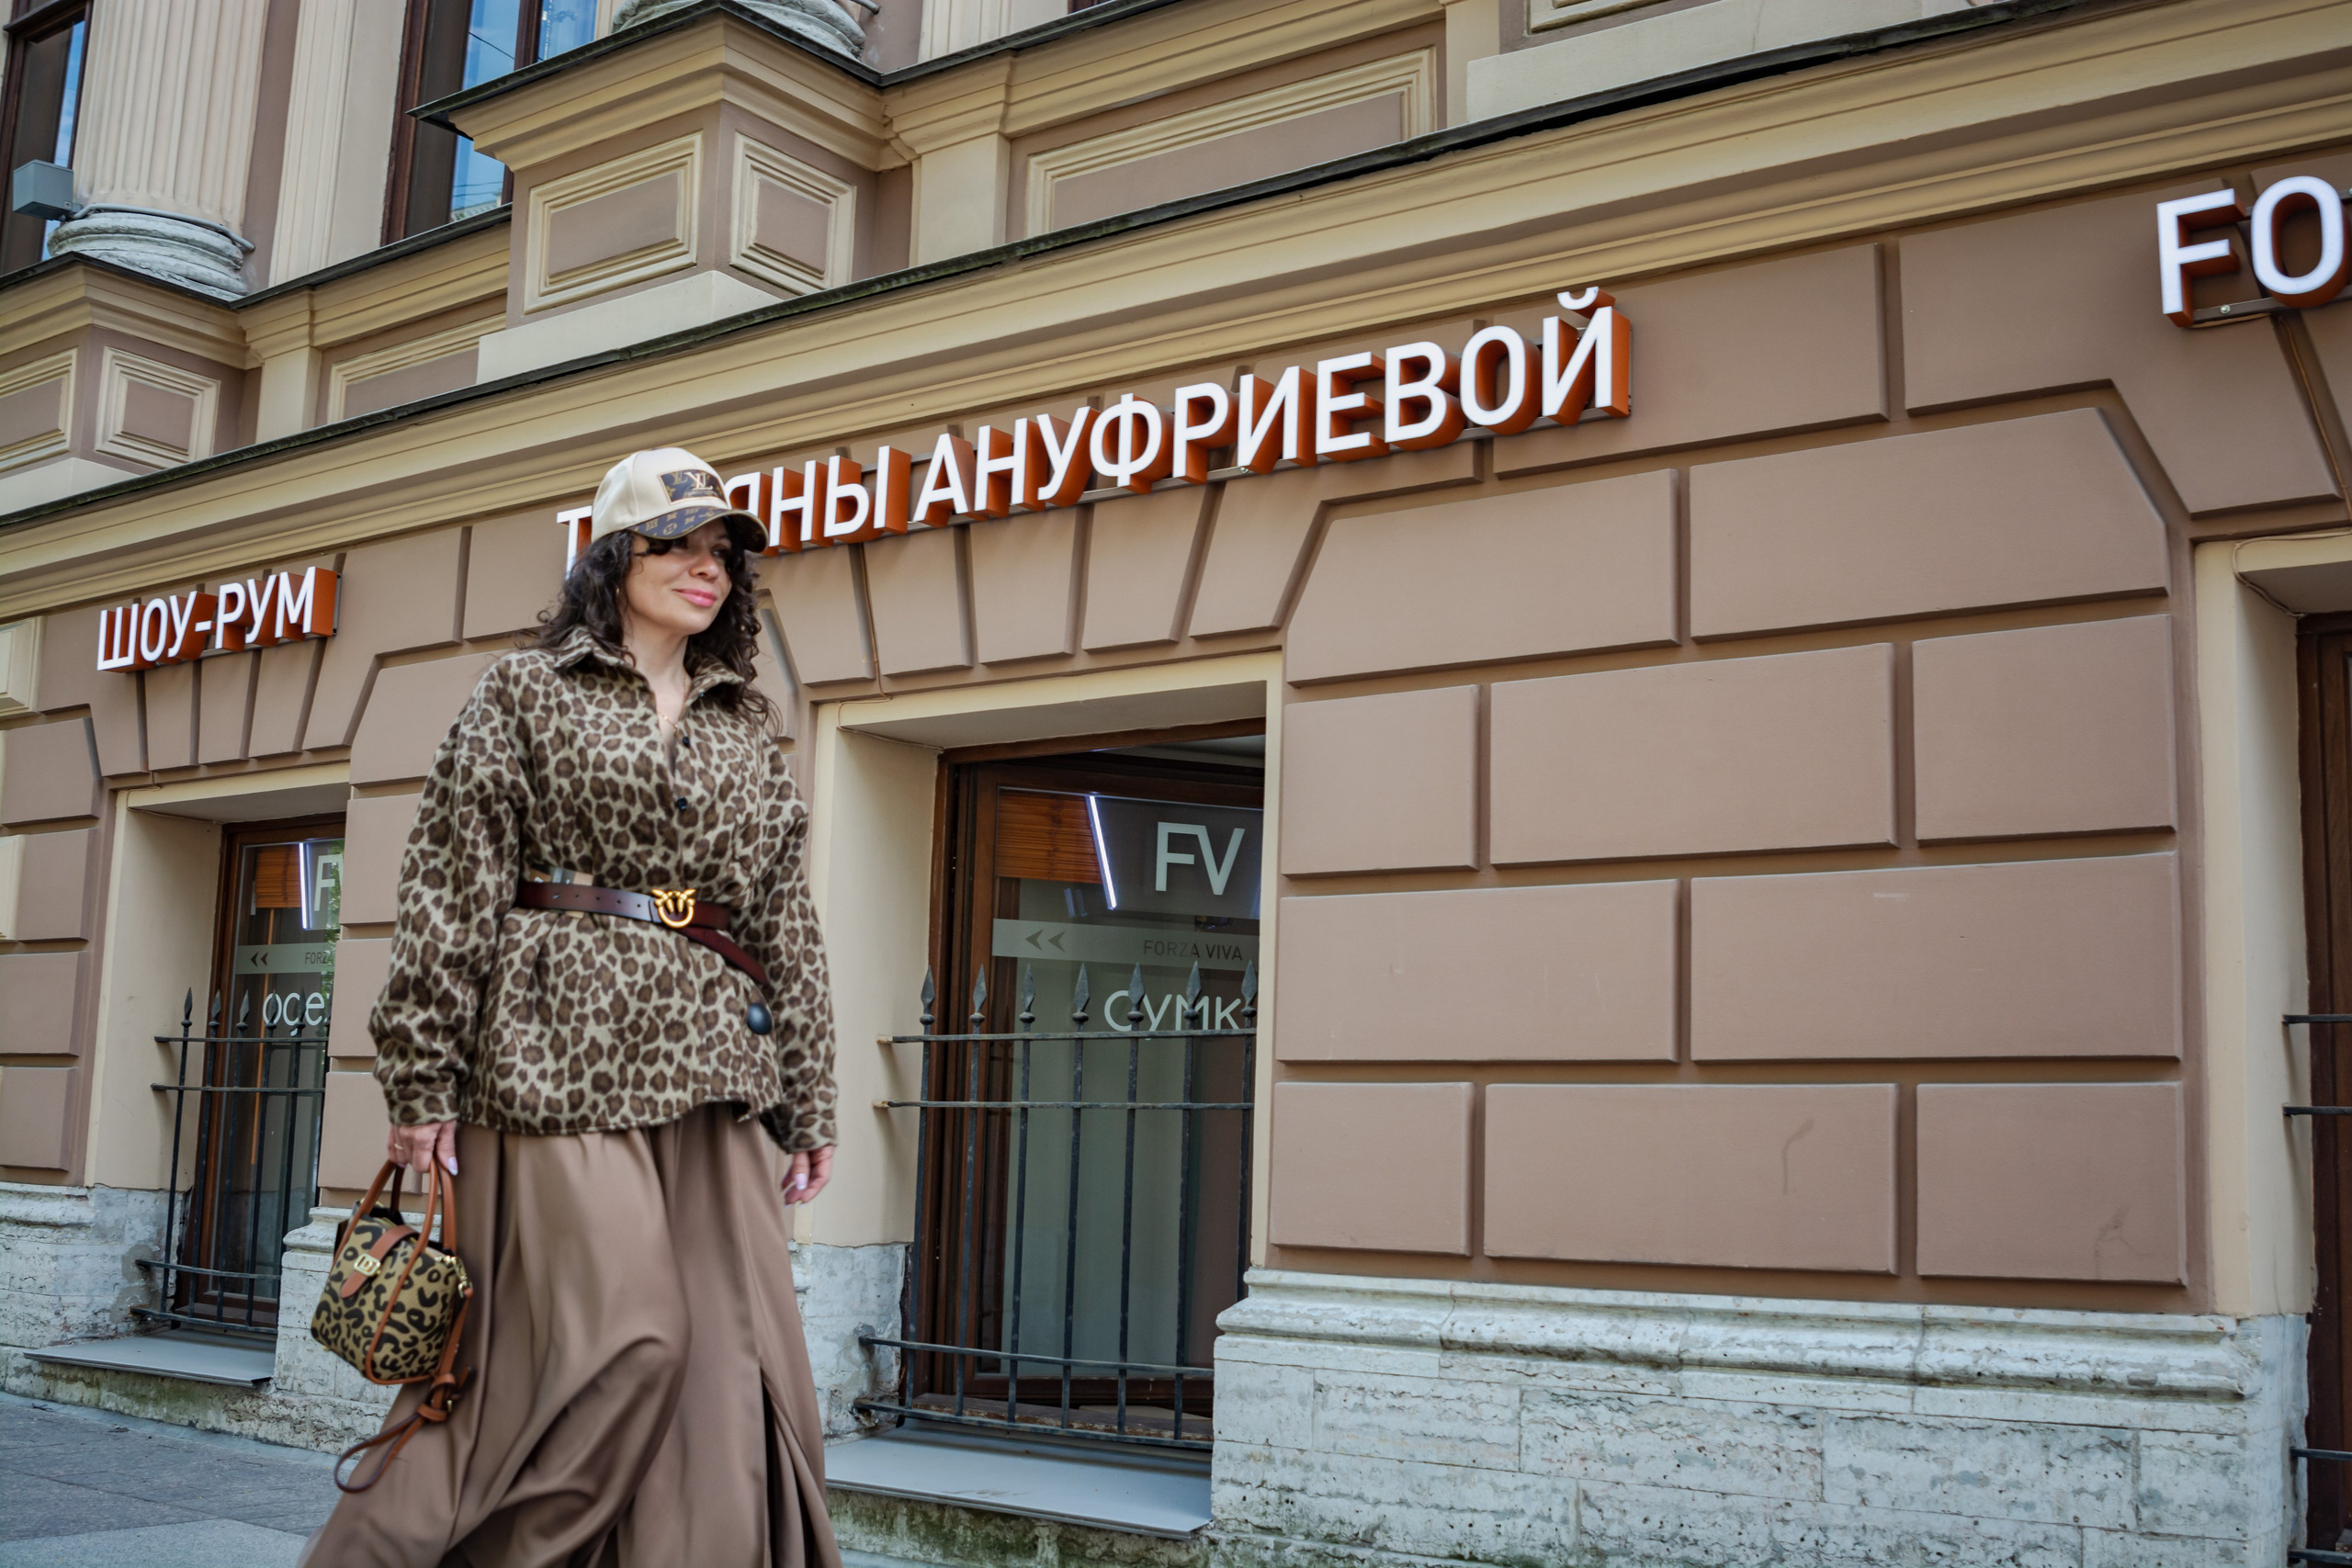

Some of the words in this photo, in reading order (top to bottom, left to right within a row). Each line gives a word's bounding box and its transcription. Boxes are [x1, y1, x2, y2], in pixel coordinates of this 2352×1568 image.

[2156, 175, 2345, 314] FO
[913, 286, 1613, 522] АНУФРИЕВОЙ
[97, 566, 316, 671] ШОУ-РУМ
[1155, 821, 1245, 896] FV
[1143, 940, 1200, 958] FORZA
[1205, 943, 1243, 961] VIVA
